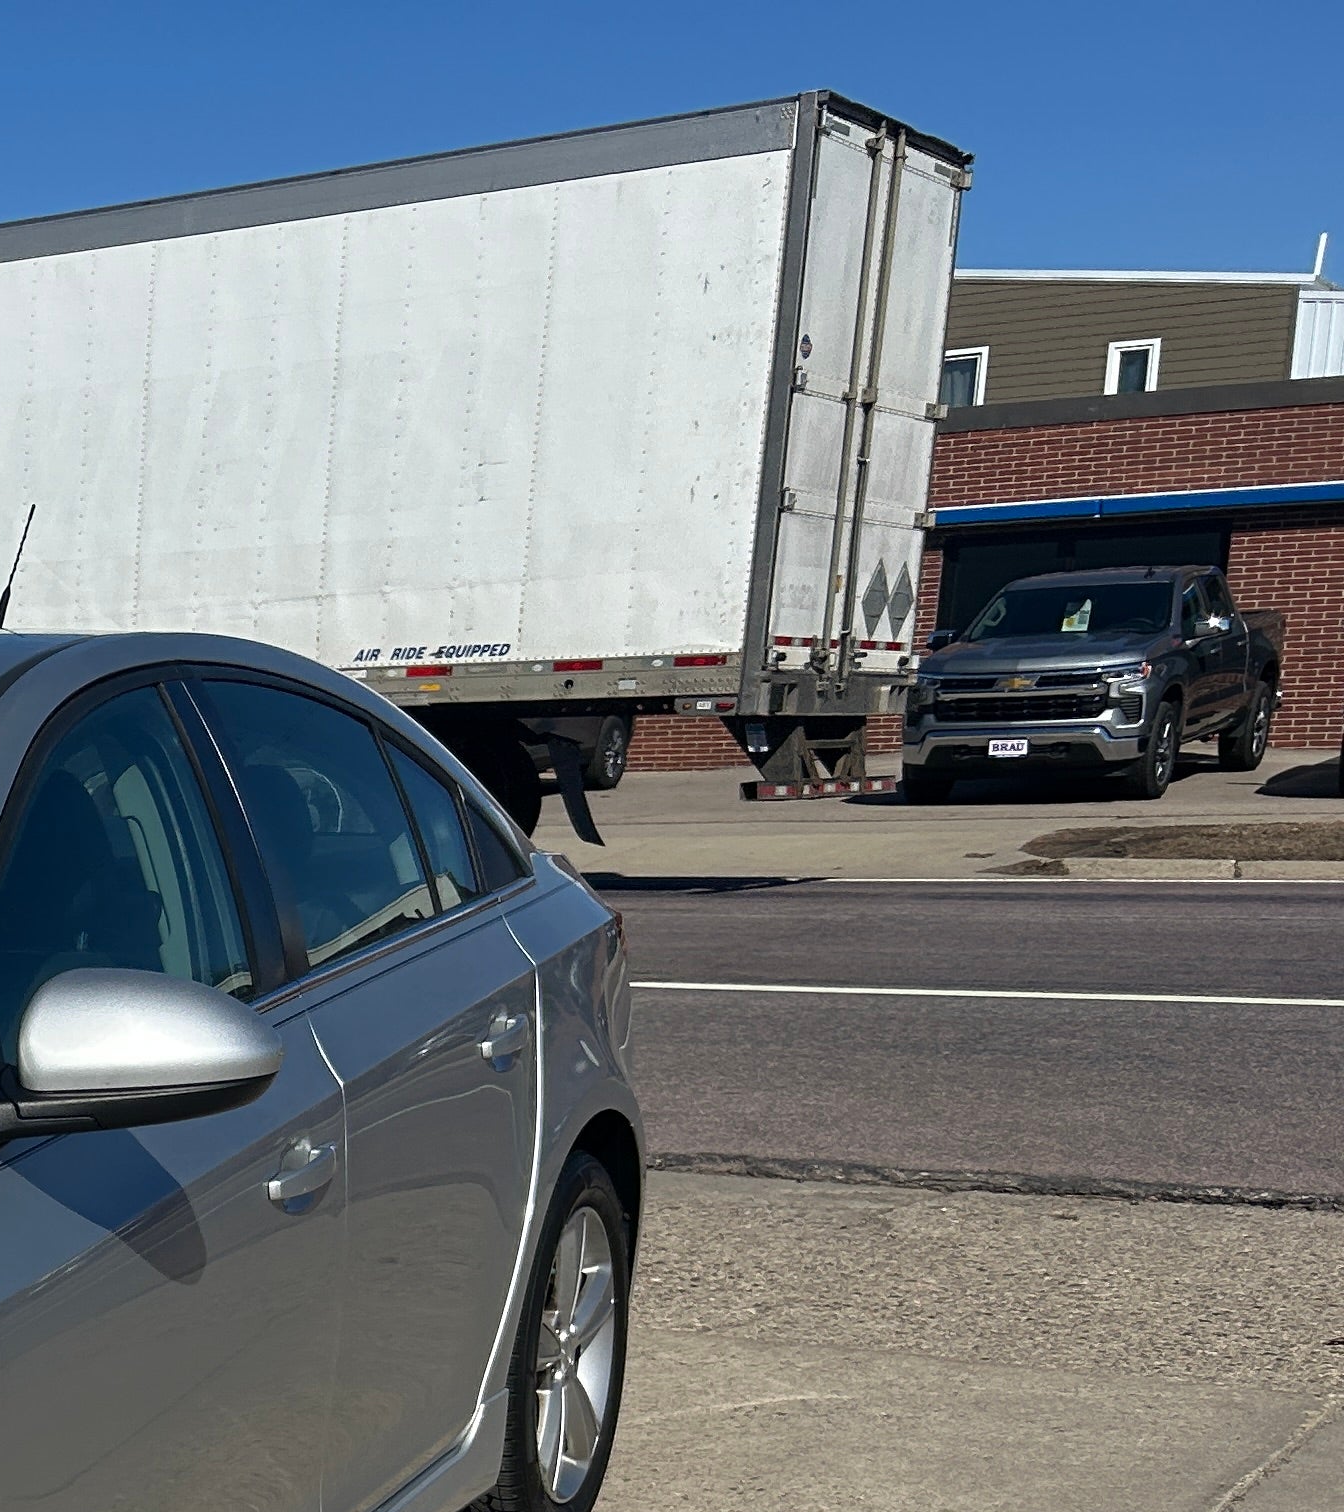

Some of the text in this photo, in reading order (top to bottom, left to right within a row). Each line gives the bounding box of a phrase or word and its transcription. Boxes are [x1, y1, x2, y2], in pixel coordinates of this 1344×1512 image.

[353, 643, 511, 662] AIR RIDE EQUIPPED
[992, 743, 1025, 752] BRAU
